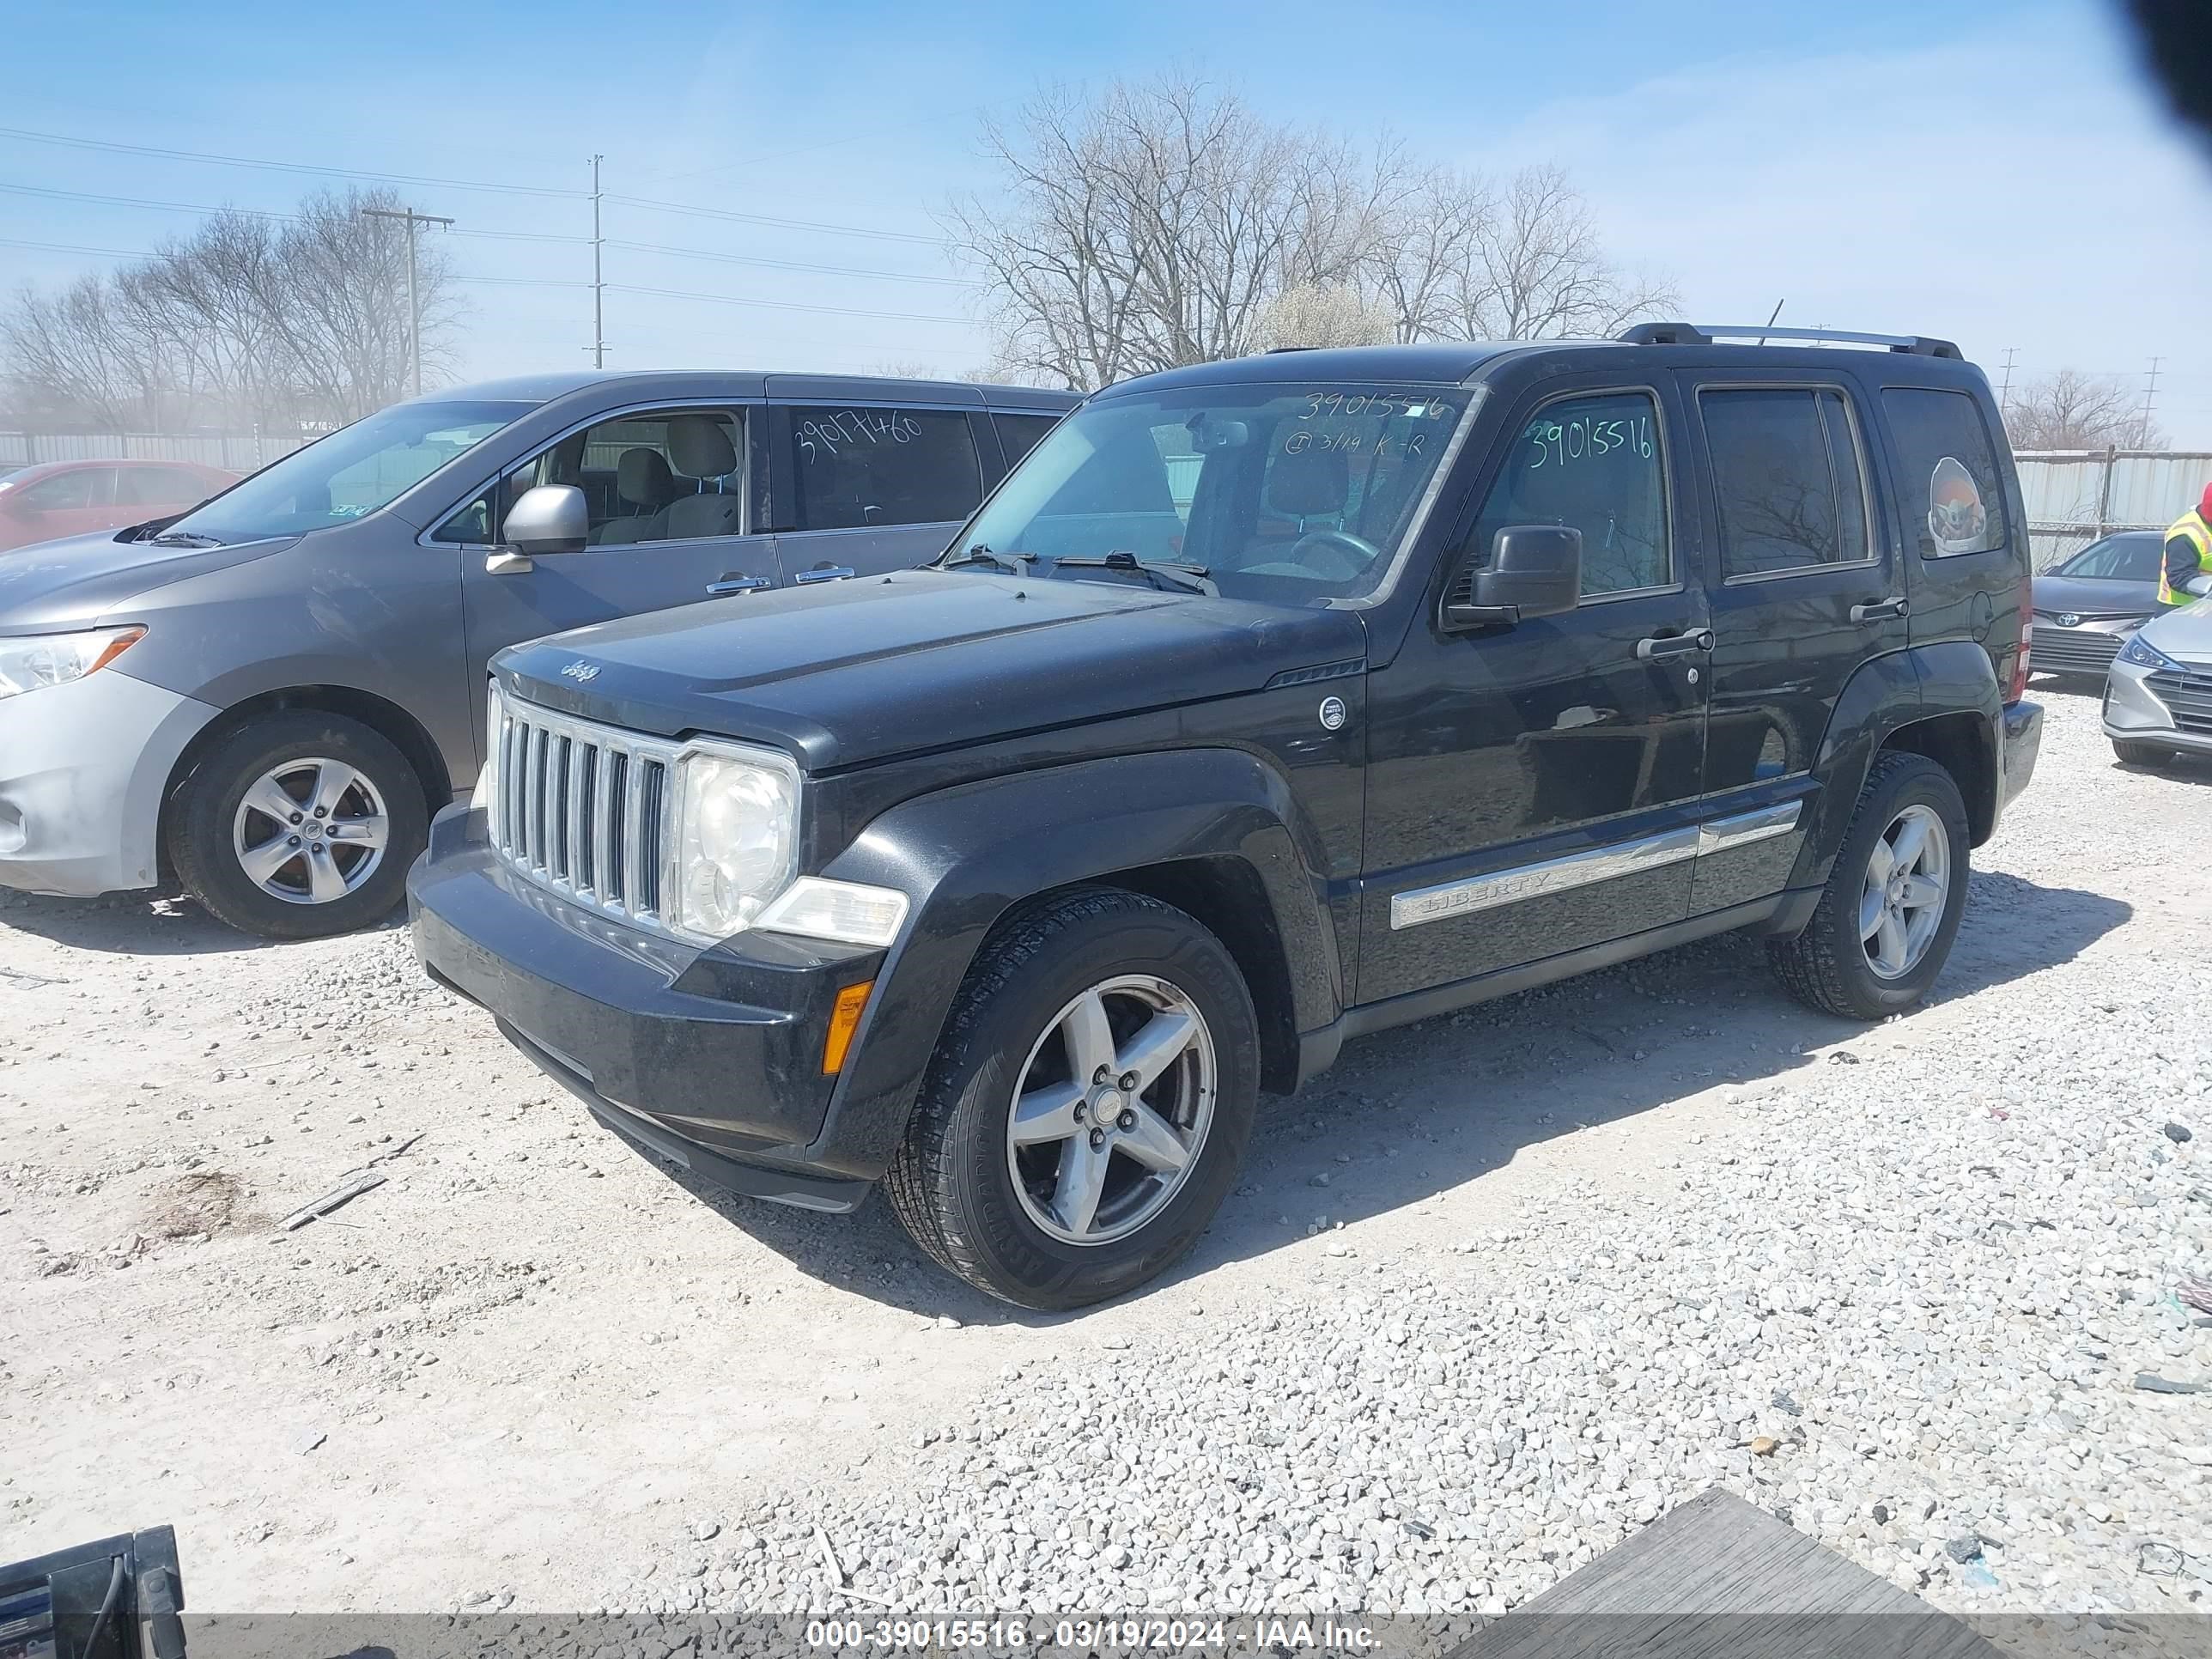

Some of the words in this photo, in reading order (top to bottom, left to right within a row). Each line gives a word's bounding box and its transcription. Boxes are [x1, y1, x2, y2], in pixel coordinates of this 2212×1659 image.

[1297, 392, 1444, 419] 39015516
[794, 409, 922, 465] 39017460
[1320, 434, 1362, 454] 3/19
[1530, 416, 1651, 469] 39015516
[1422, 872, 1551, 913] LIBERTY
